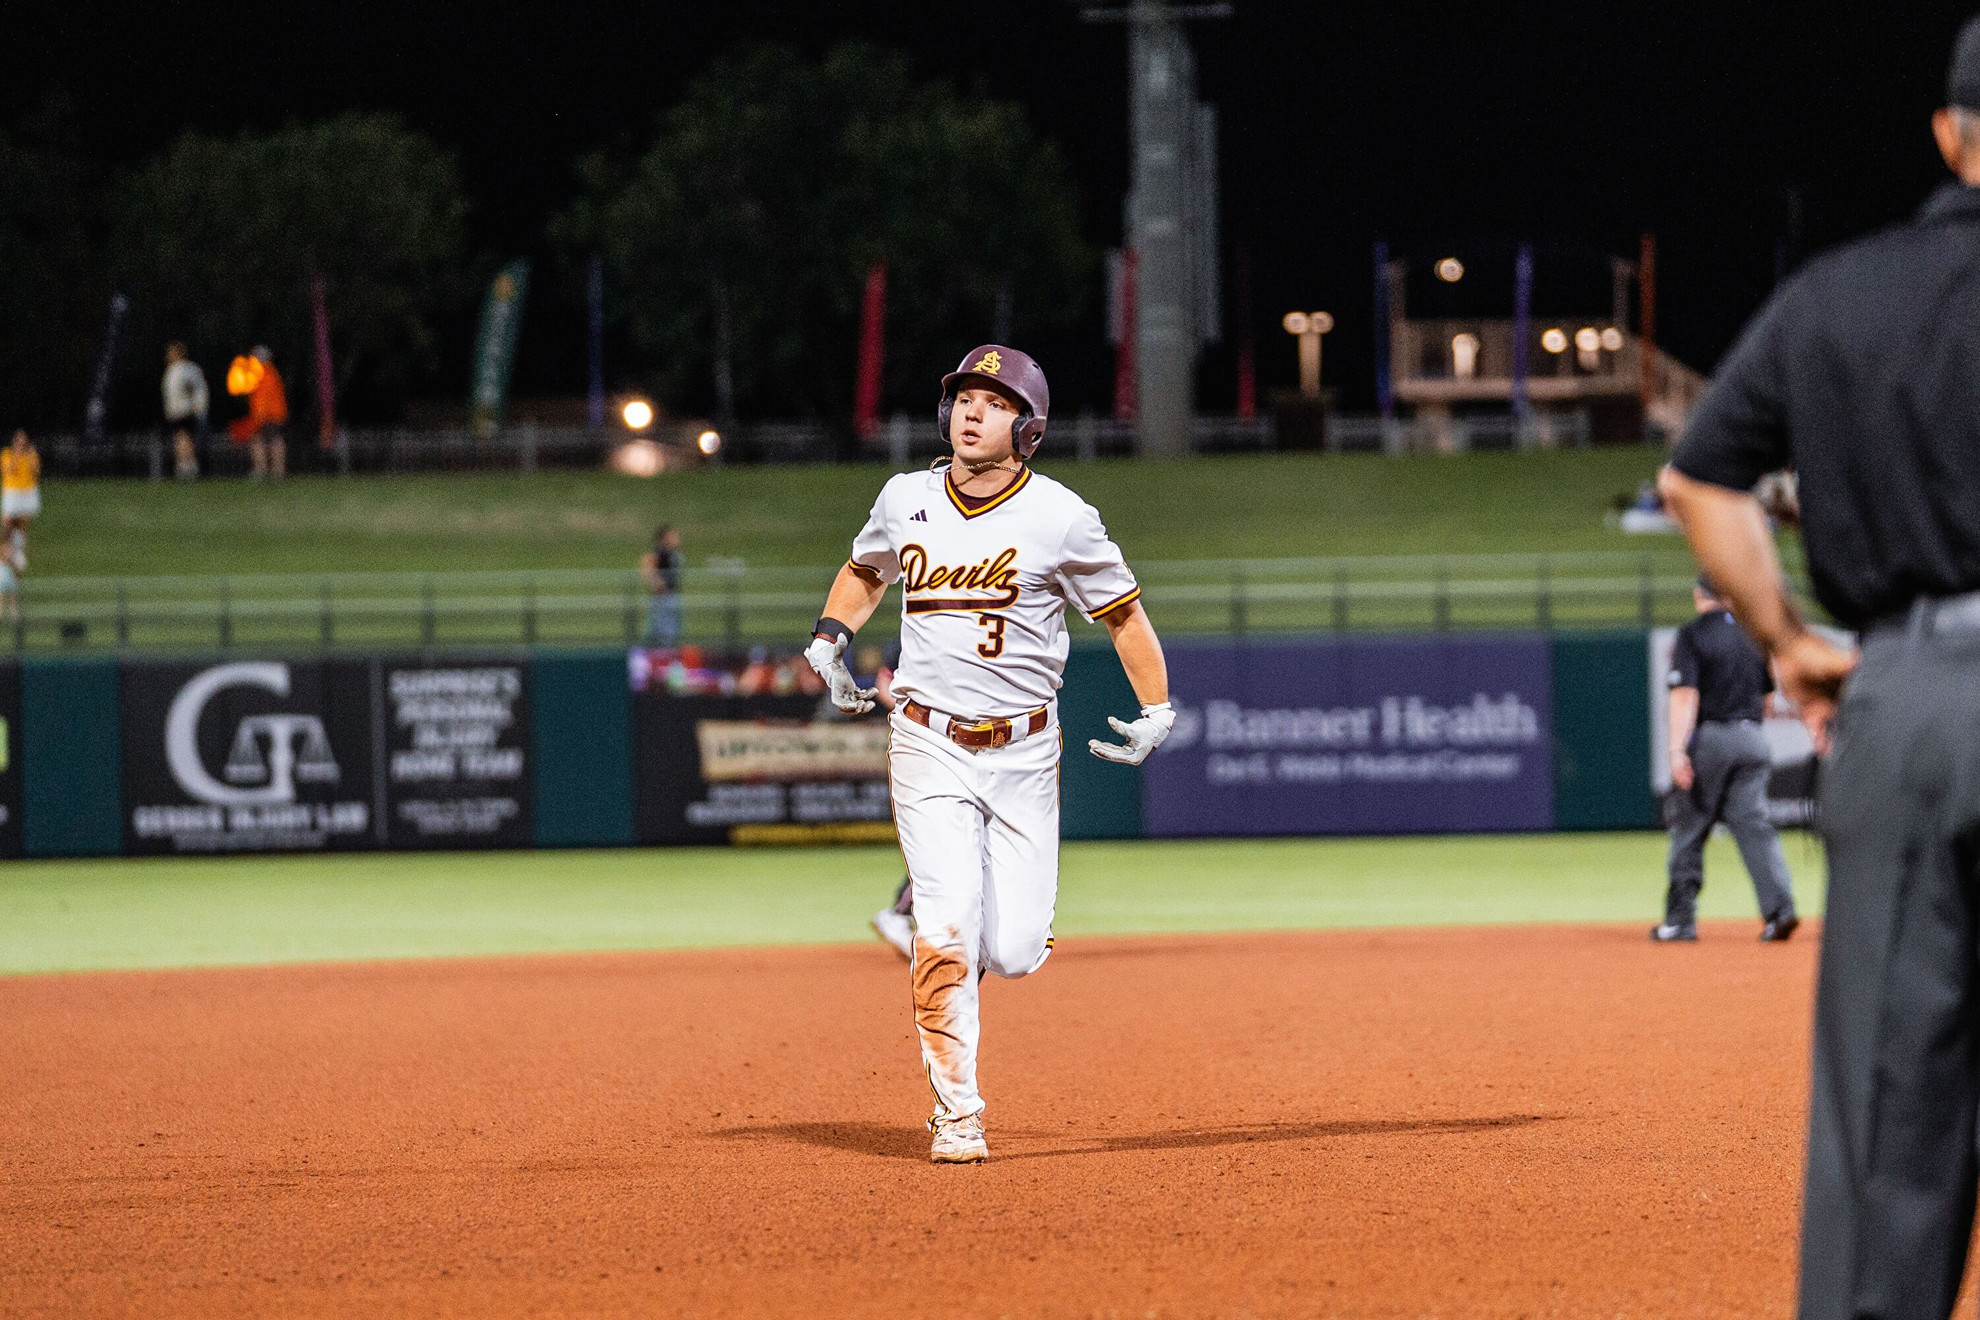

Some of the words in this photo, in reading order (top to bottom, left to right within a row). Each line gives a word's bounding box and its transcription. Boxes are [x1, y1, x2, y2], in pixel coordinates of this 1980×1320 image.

[899, 543, 1020, 597] Devils
[977, 613, 1006, 659] 3
[1206, 699, 1370, 747] Banner
[1381, 693, 1538, 745] Health
